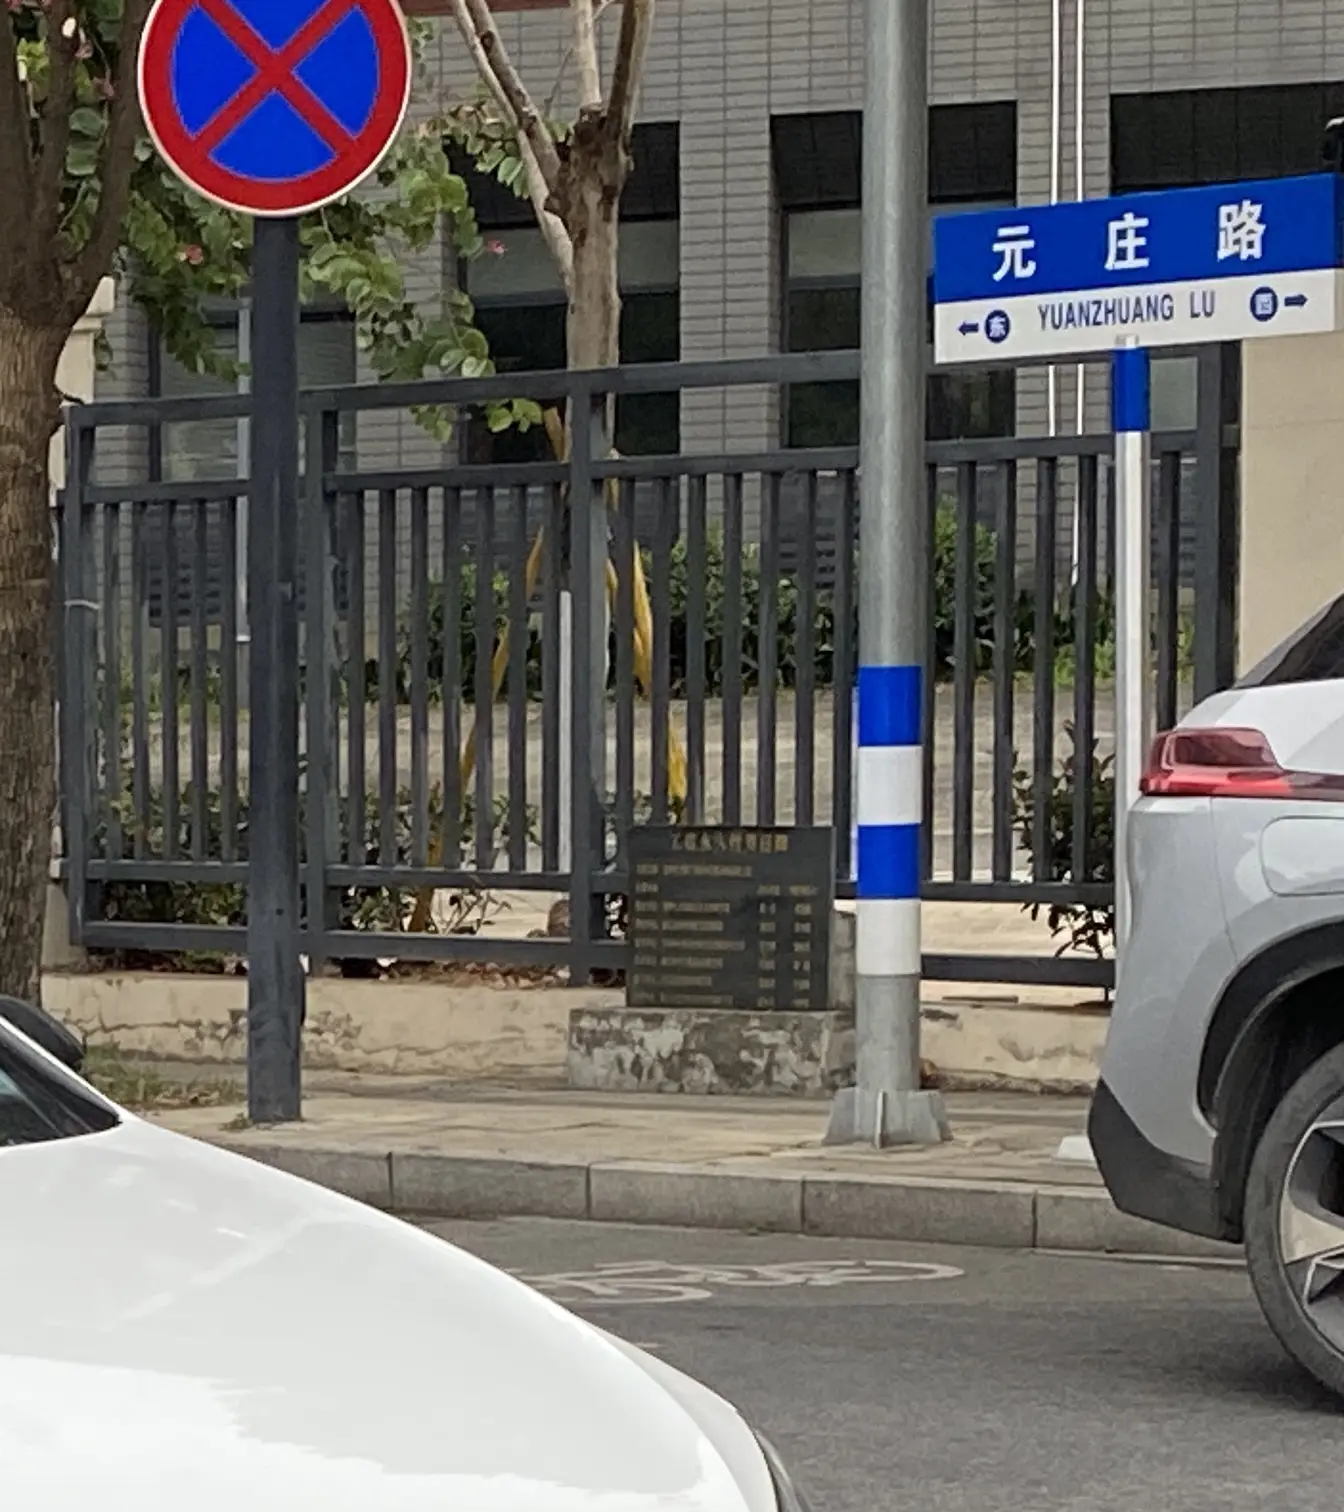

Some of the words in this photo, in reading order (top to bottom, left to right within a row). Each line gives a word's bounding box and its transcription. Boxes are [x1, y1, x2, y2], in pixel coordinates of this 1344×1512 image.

[992, 199, 1266, 282] 元庄路
[988, 315, 1006, 338] 东
[1038, 294, 1175, 331] YUANZHUANG
[1189, 290, 1216, 319] LU
